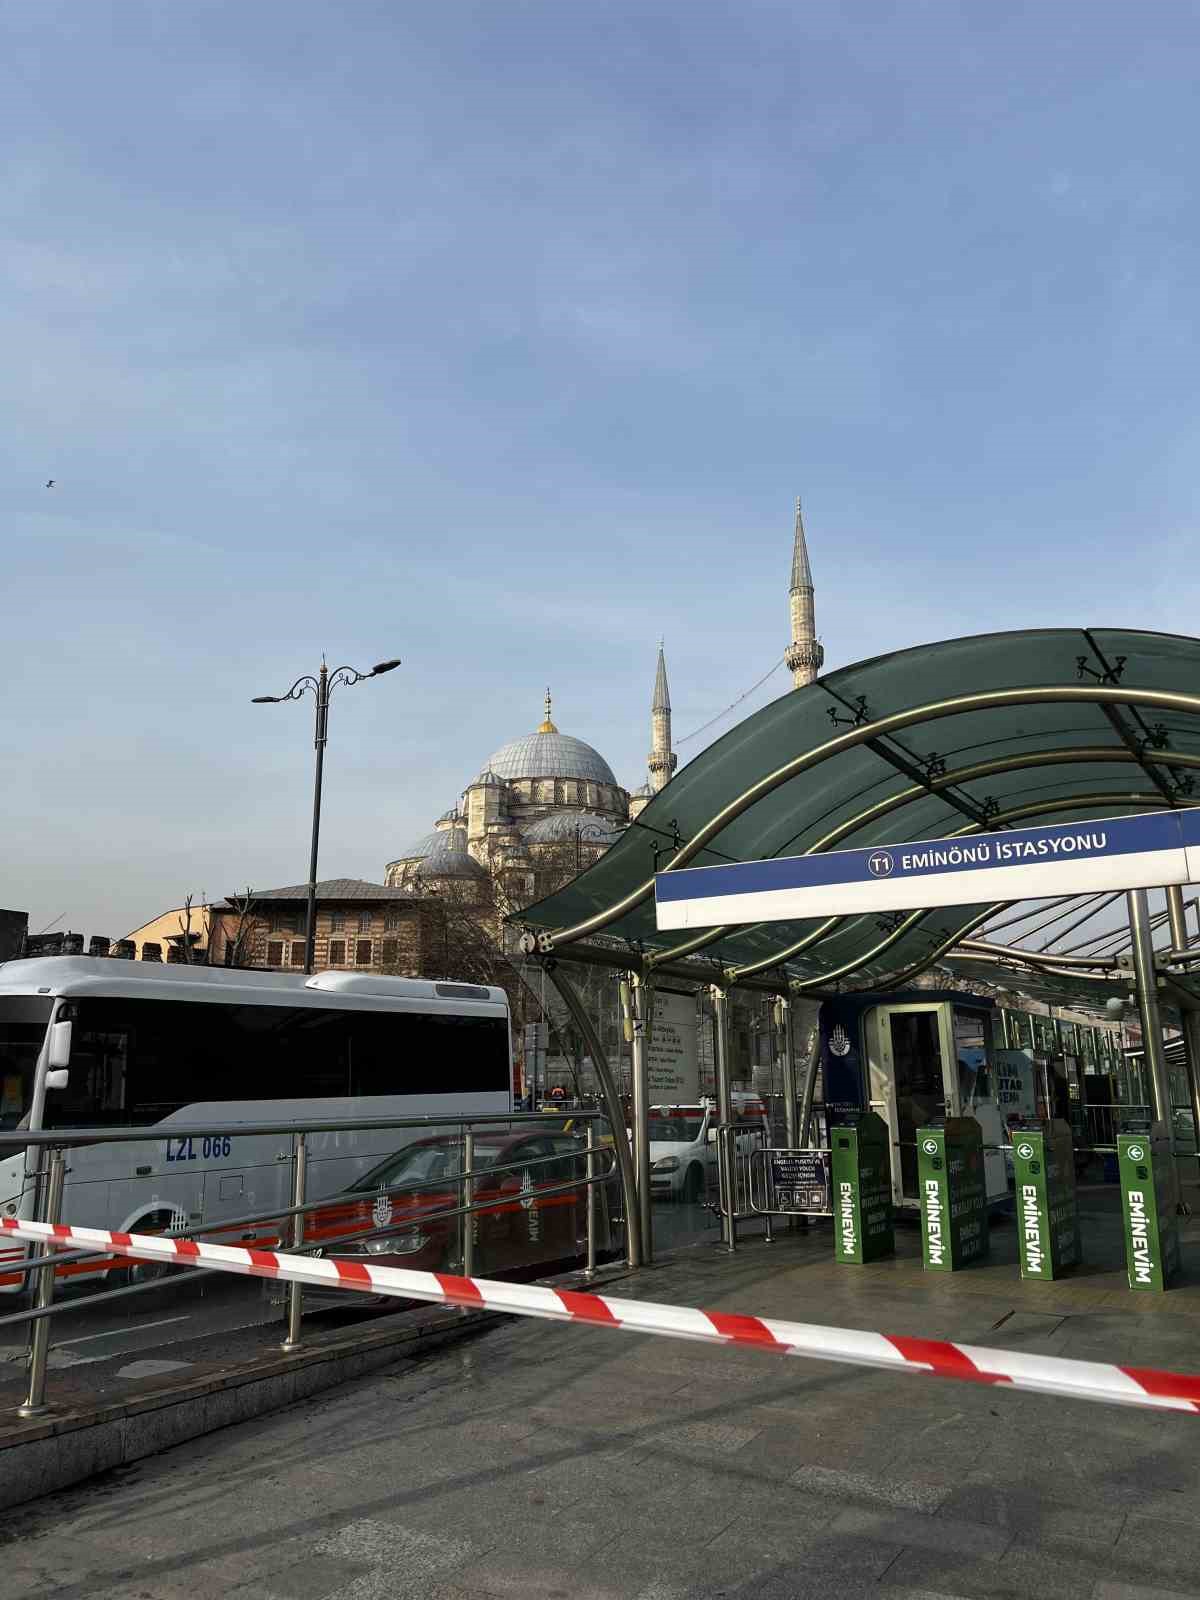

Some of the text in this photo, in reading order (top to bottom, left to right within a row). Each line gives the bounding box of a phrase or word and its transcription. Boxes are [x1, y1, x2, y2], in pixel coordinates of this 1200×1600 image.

[902, 843, 990, 870] EMİNÖNÜ
[996, 832, 1107, 860] İSTASYONU
[203, 1136, 231, 1158] 066
[840, 1182, 857, 1255] EMİNEVİM
[925, 1180, 946, 1264] EMİNEVİM
[1022, 1185, 1045, 1273] EMİNEVİM
[1127, 1191, 1155, 1283] EMİNEVİM
